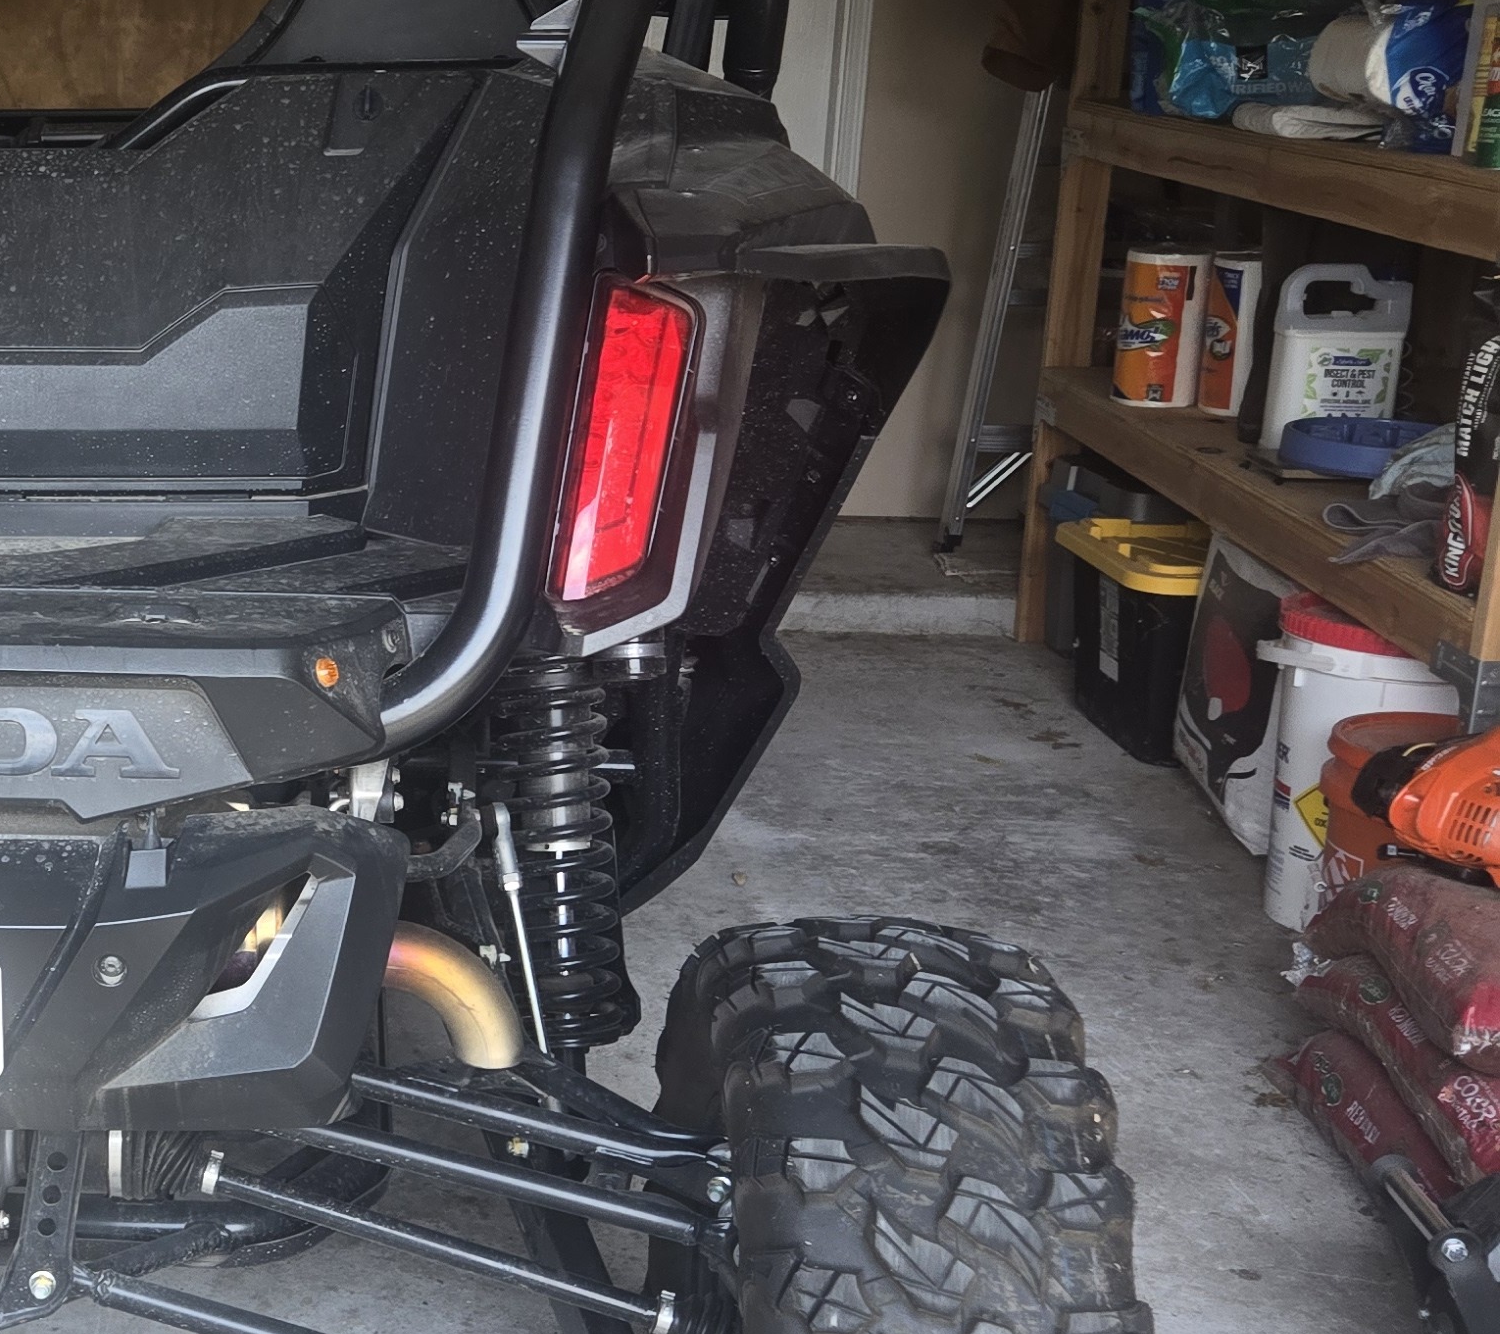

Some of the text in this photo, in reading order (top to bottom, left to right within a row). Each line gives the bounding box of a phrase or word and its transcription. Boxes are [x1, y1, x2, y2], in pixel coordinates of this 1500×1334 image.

[1324, 369, 1350, 378] INSECT
[1358, 370, 1376, 379] PEST
[1331, 379, 1366, 388] CONTROL
[1456, 388, 1481, 457] MATCH
